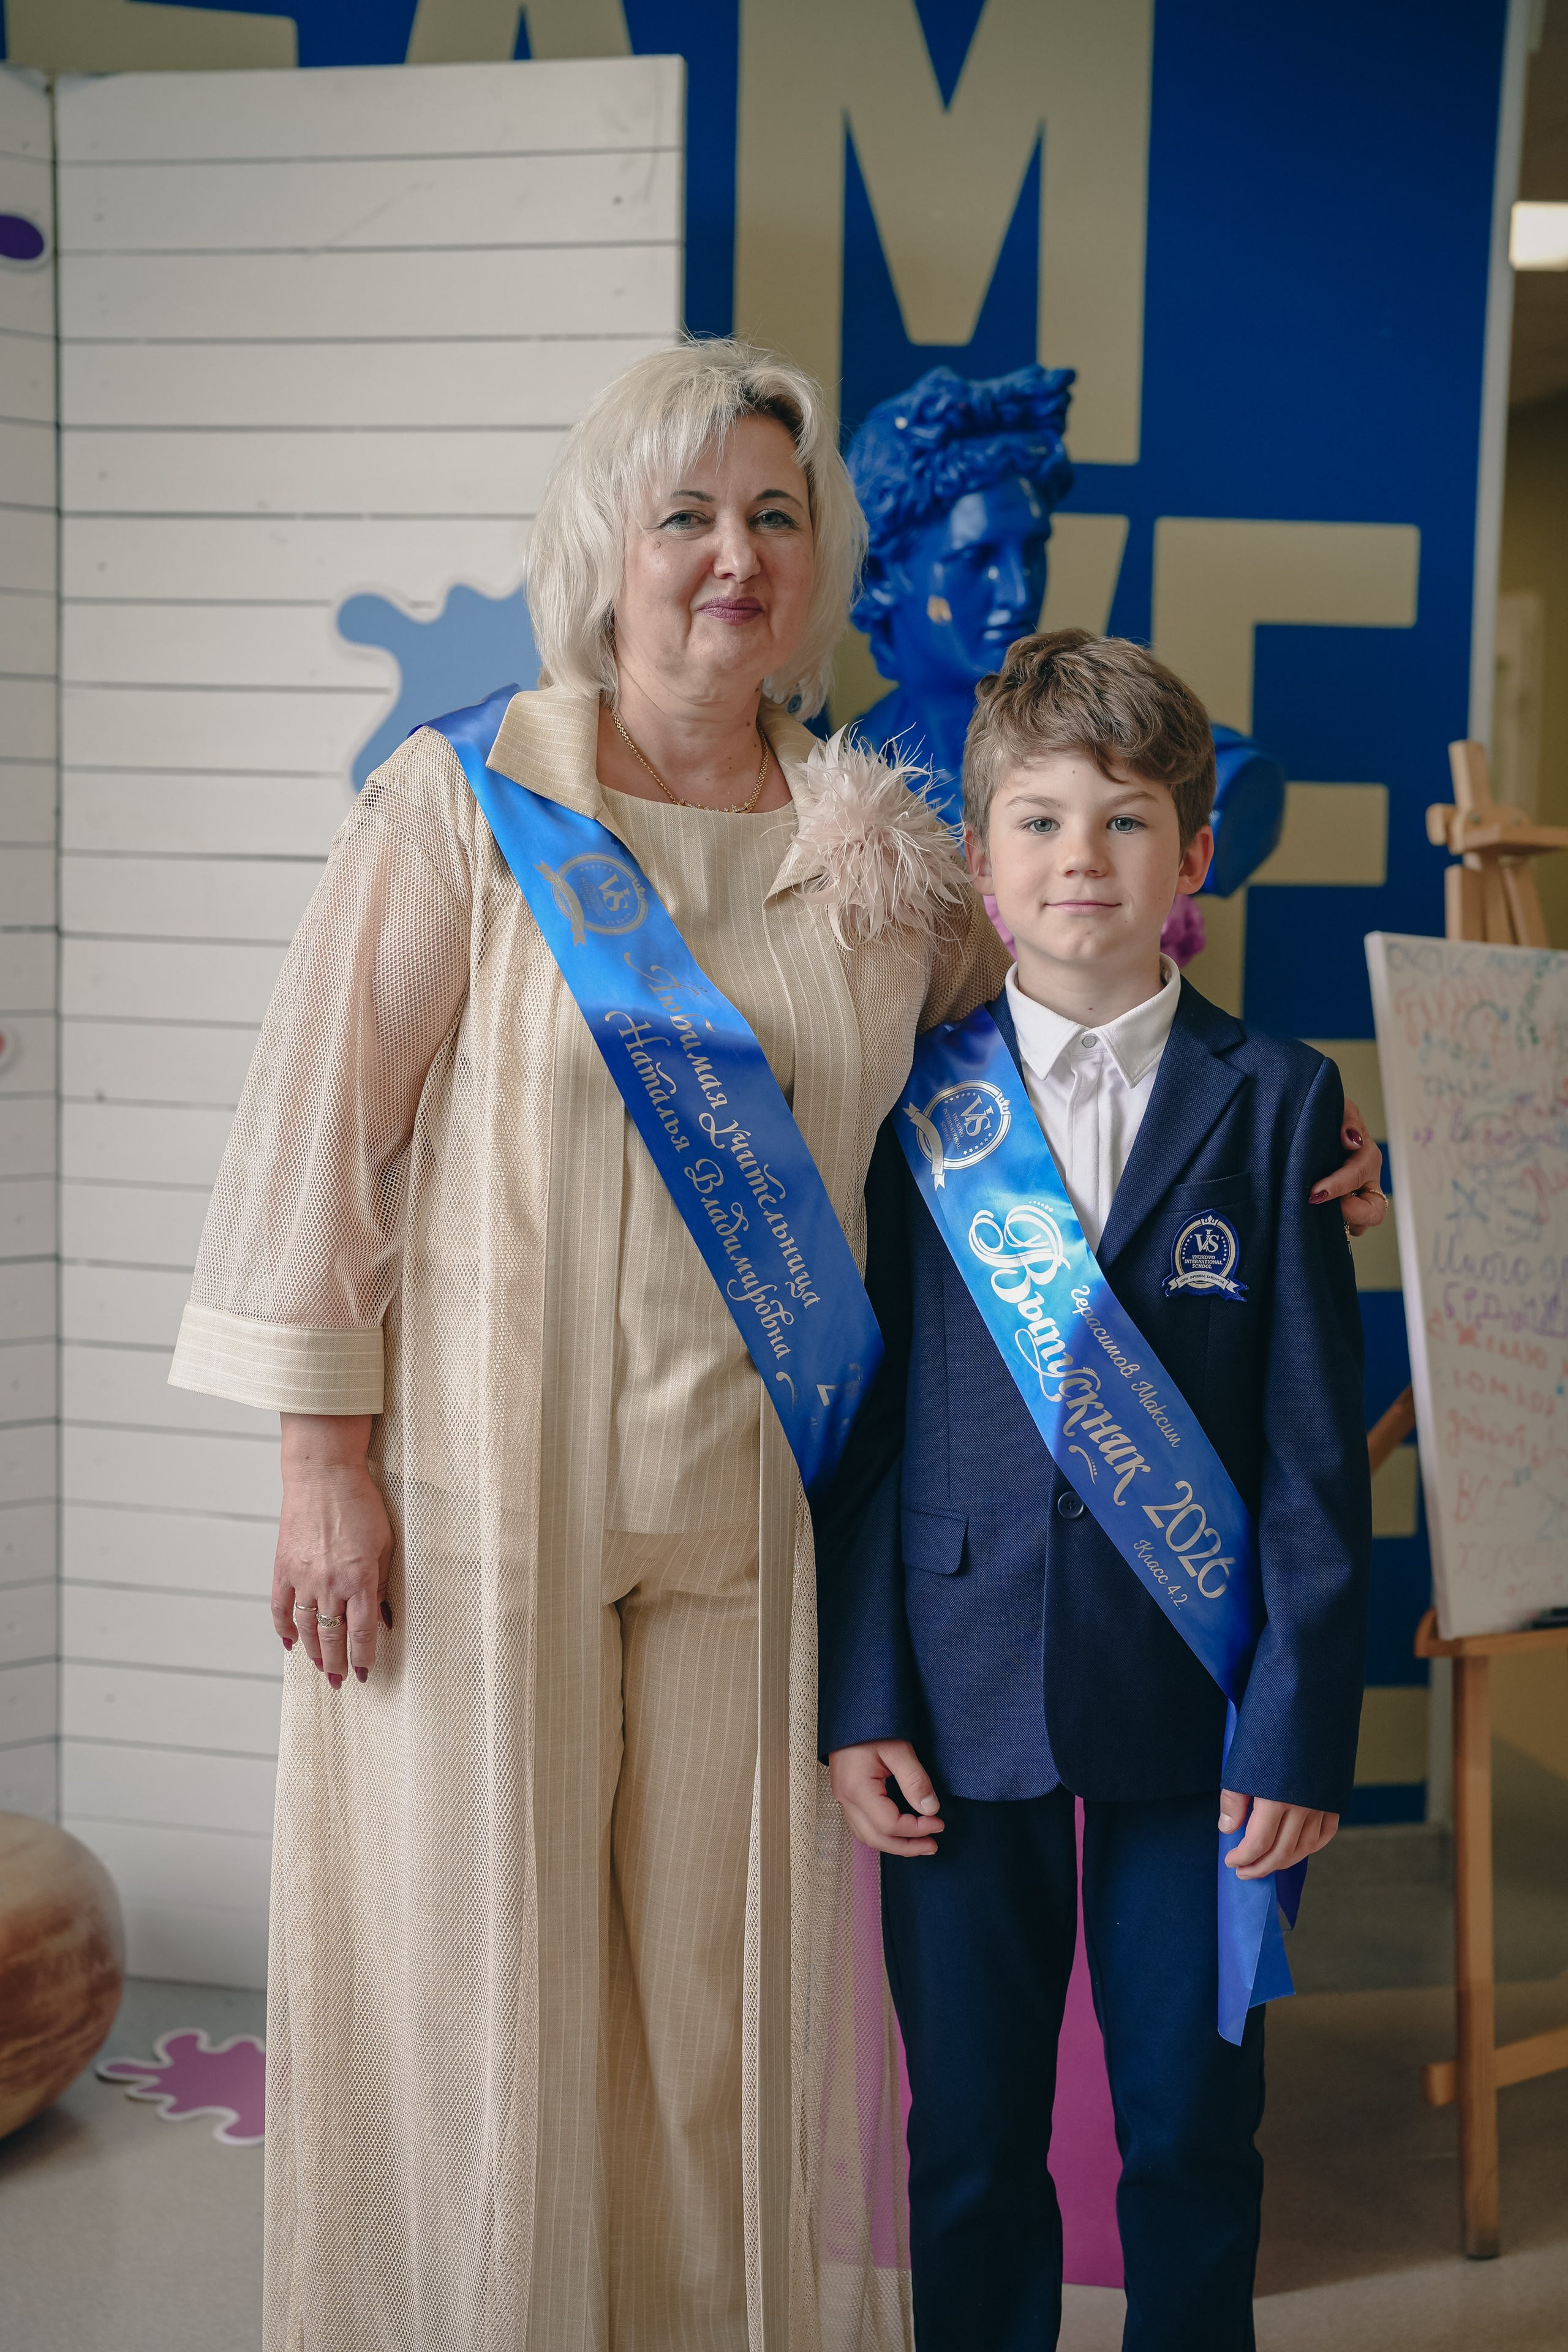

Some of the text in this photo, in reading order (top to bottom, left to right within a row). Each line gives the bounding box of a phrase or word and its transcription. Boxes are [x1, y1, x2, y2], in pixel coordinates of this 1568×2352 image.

[624, 952, 728, 1110] Любимая
[940, 1121, 951, 1144] SCHOOL
[943, 1107, 961, 1150] INTERNATIONAL
[952, 1112, 965, 1138] VNUKOVO
[605, 1010, 792, 1360] Наталья Владимировна
[968, 1204, 1236, 1599] Выпускник 2026
[1070, 1285, 1182, 1449] Герасимов Максим
[1133, 1539, 1168, 1585] Класс
